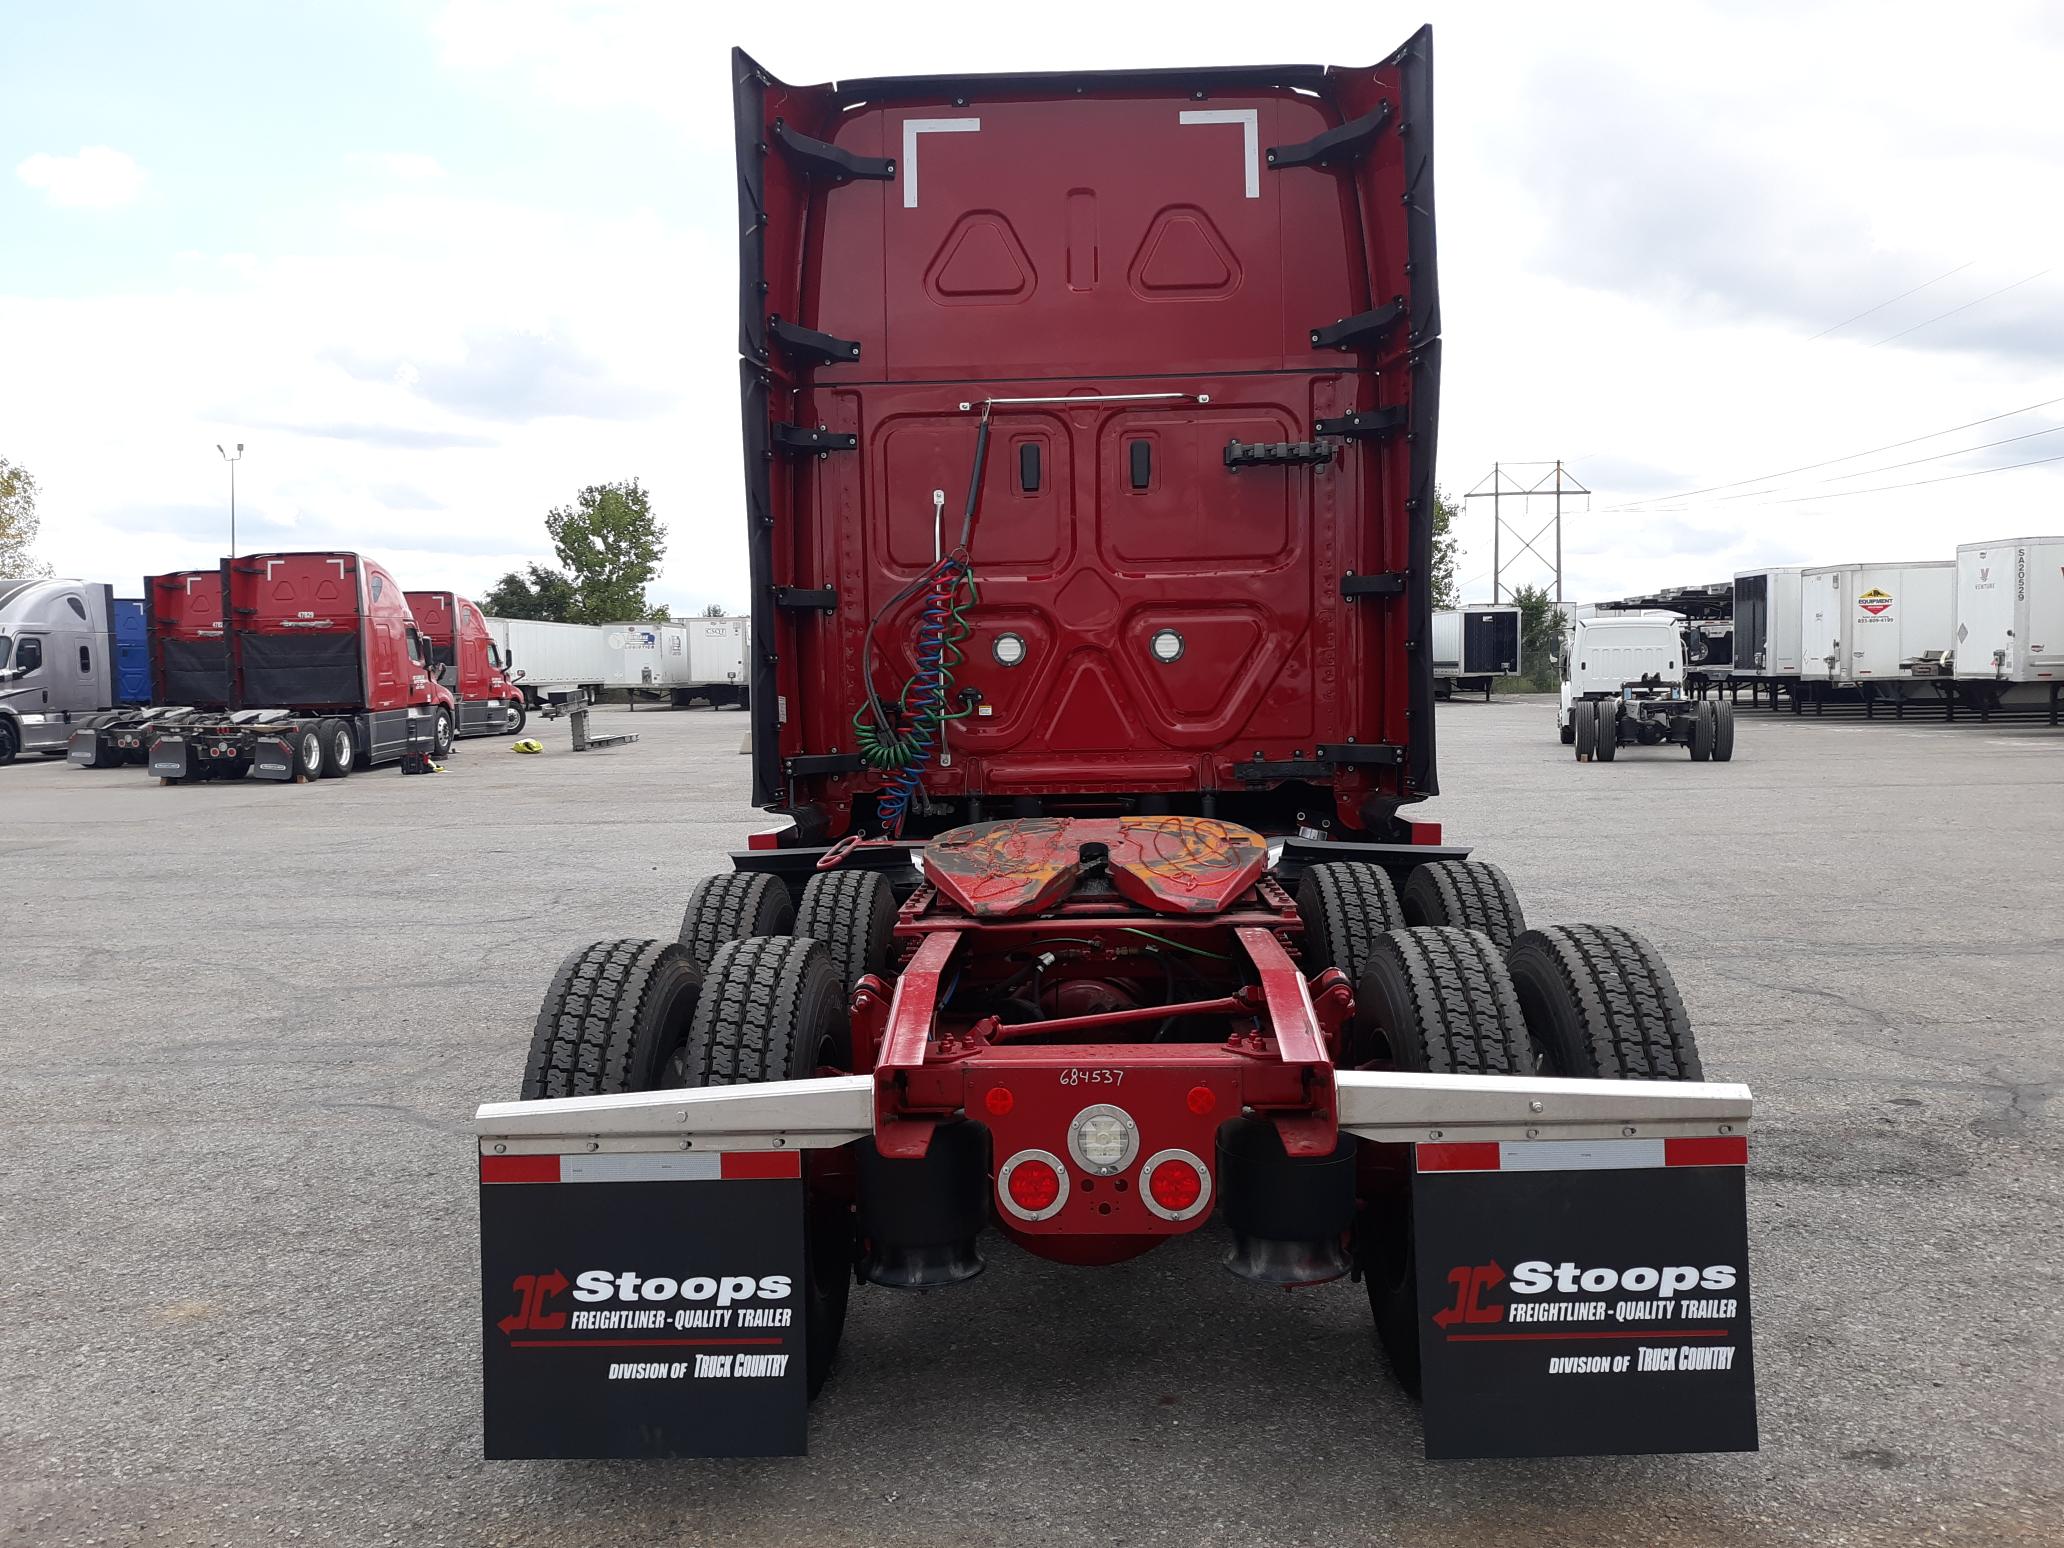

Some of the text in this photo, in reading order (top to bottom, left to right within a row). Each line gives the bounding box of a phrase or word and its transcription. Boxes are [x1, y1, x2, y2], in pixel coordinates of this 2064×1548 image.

[1059, 1069, 1124, 1086] 684537
[572, 1270, 792, 1307] Stoops
[1509, 1261, 1737, 1298] Stoops
[737, 1308, 792, 1327] TRAILER
[1680, 1299, 1737, 1319] TRAILER
[608, 1354, 789, 1380] DIVISION OF TRUCK COUNTRY
[1549, 1346, 1736, 1374] DIVISION OF TRUCK COUNTRY
